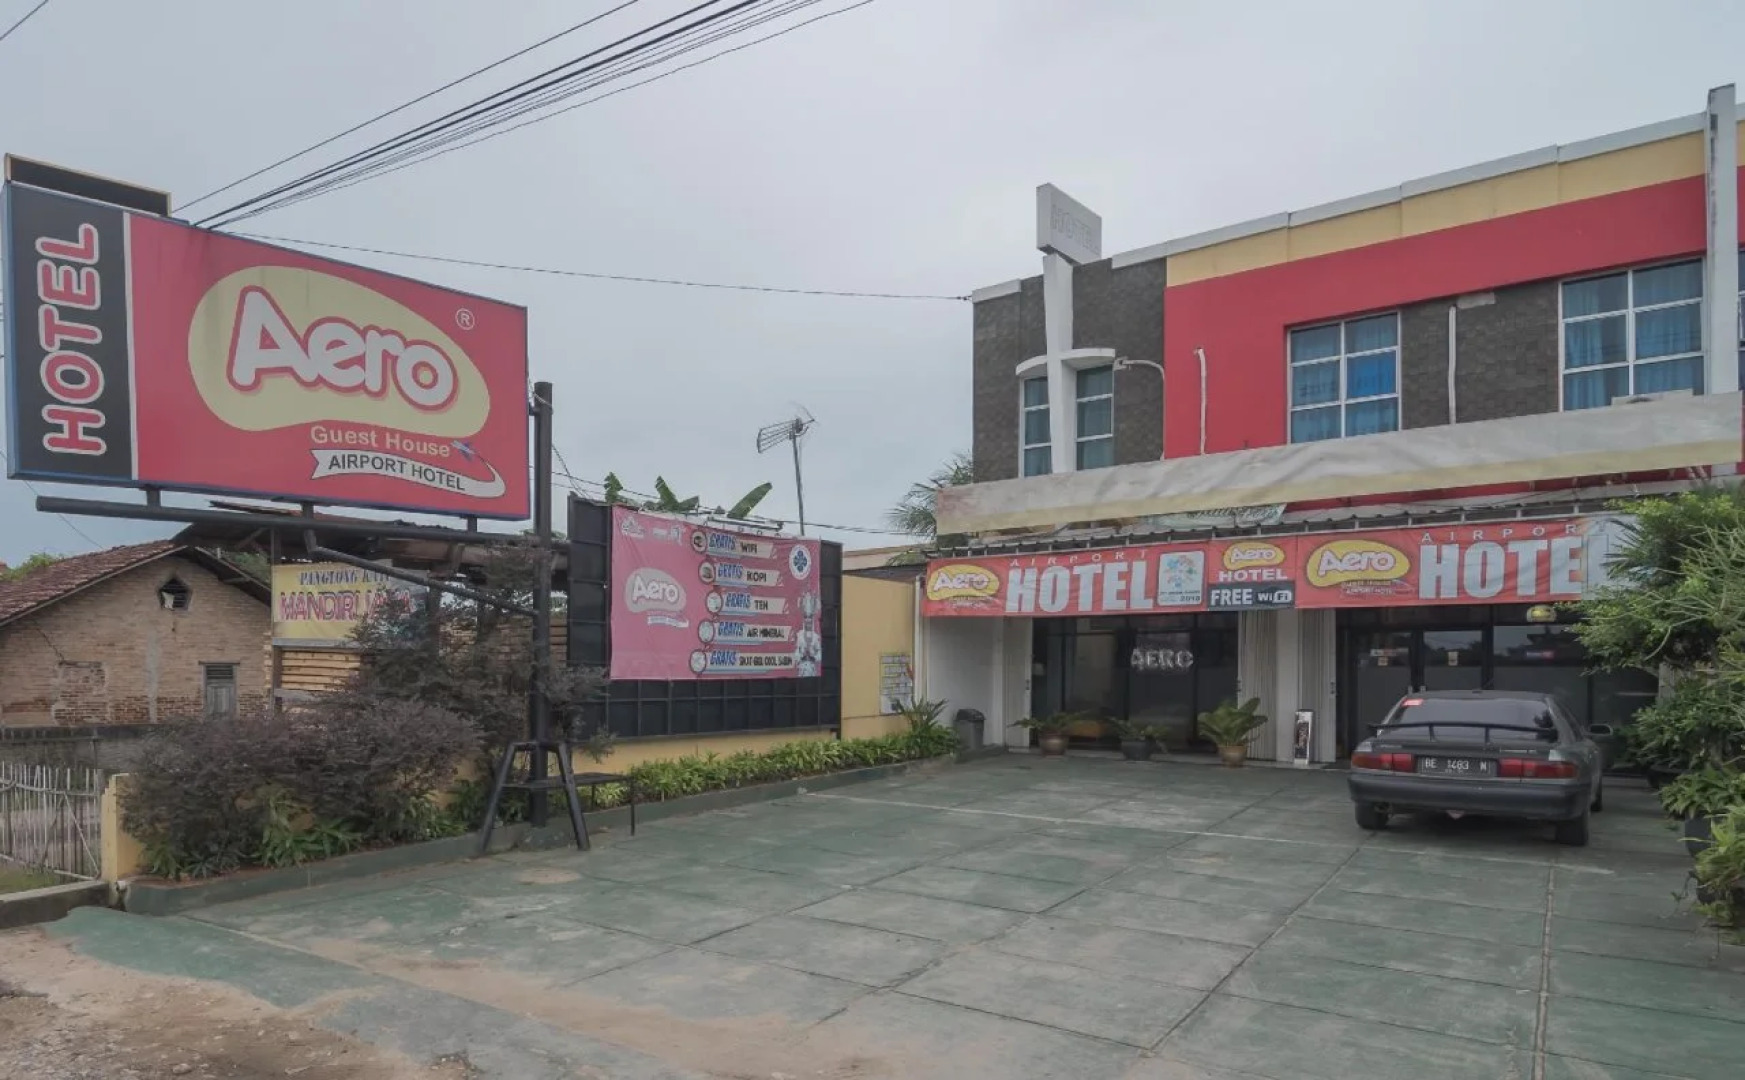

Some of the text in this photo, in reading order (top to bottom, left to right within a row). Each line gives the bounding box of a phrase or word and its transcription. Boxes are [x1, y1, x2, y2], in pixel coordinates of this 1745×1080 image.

[35, 223, 107, 455] HOTEL
[227, 285, 459, 413] Aero
[310, 425, 450, 457] Guest House
[328, 454, 466, 491] AIRPORT HOTEL
[1009, 549, 1148, 567] AIRPORT
[1230, 547, 1277, 563] Aero
[1317, 550, 1397, 576] Aero
[746, 571, 767, 582] KOPI
[933, 570, 990, 592] Aero
[1005, 560, 1153, 613] HOTEL
[1218, 568, 1288, 582] HOTEL
[632, 575, 680, 604] Aero
[1210, 588, 1253, 606] FREE
[1425, 757, 1438, 769] BE
